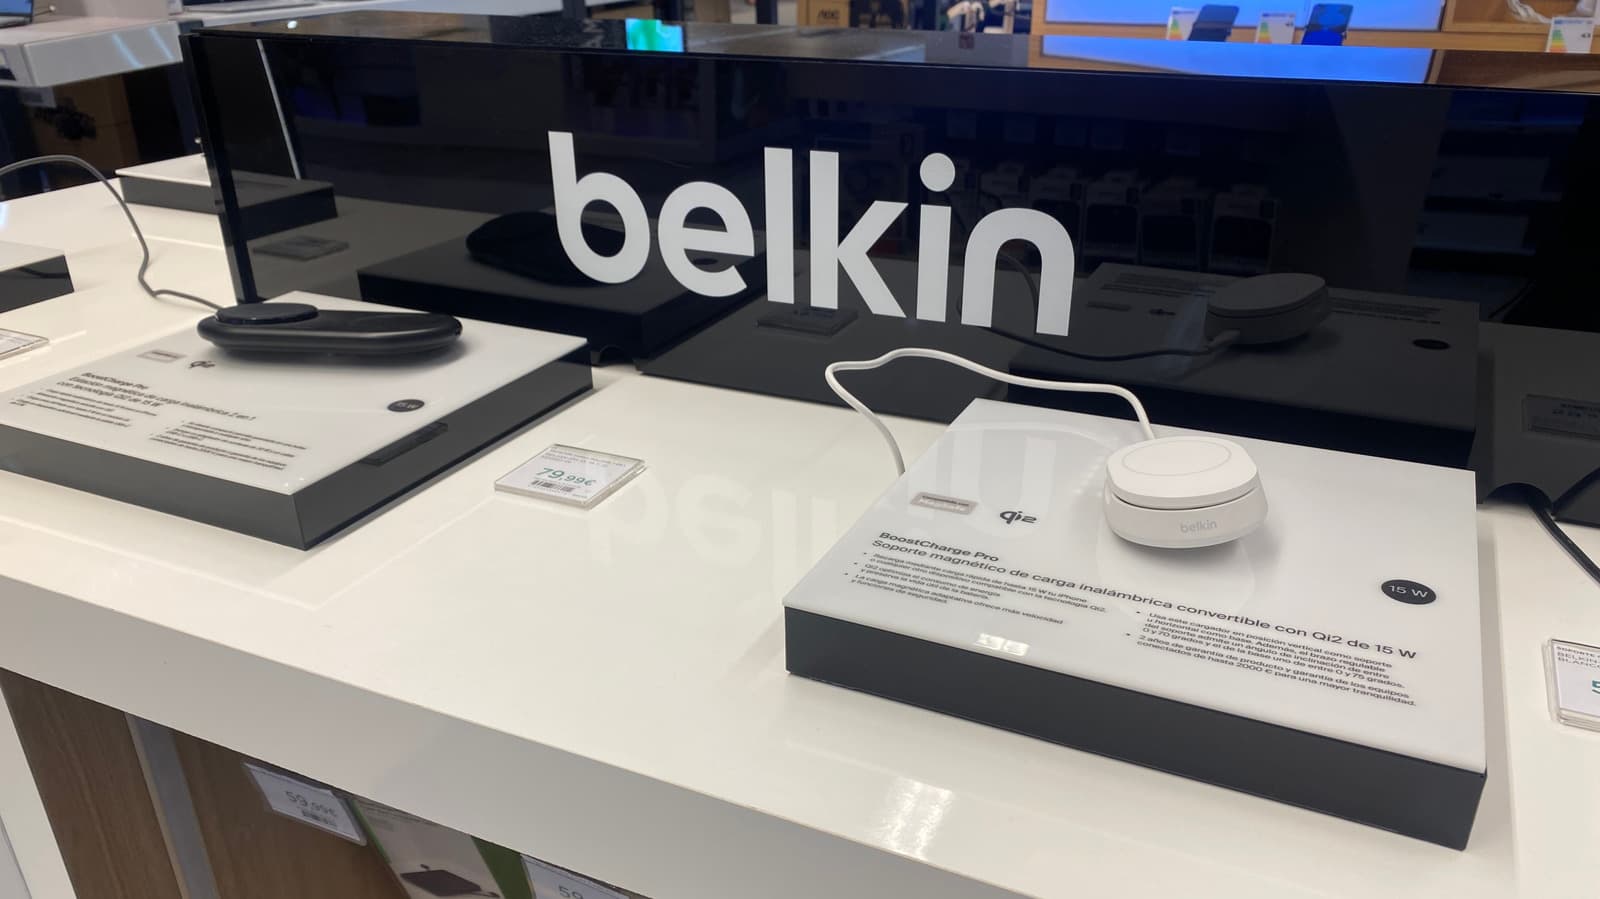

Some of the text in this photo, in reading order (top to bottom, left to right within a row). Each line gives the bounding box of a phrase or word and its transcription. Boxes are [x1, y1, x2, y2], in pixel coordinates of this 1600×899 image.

[548, 130, 1075, 336] belkin
[536, 467, 597, 487] 79,99€
[1180, 519, 1217, 533] belkin
[879, 532, 999, 562] BoostCharge Pro
[872, 540, 1417, 659] Soporte magnético de carga inalámbrica convertible con Qi2 de 15 W
[1388, 585, 1428, 598] 15 W
[1148, 612, 1167, 620] Usa
[1189, 620, 1231, 634] cargador
[1323, 650, 1352, 659] como
[1354, 656, 1392, 668] soporte
[1235, 661, 1263, 672] 2000
[1298, 675, 1318, 684] una
[1335, 677, 1349, 685] de
